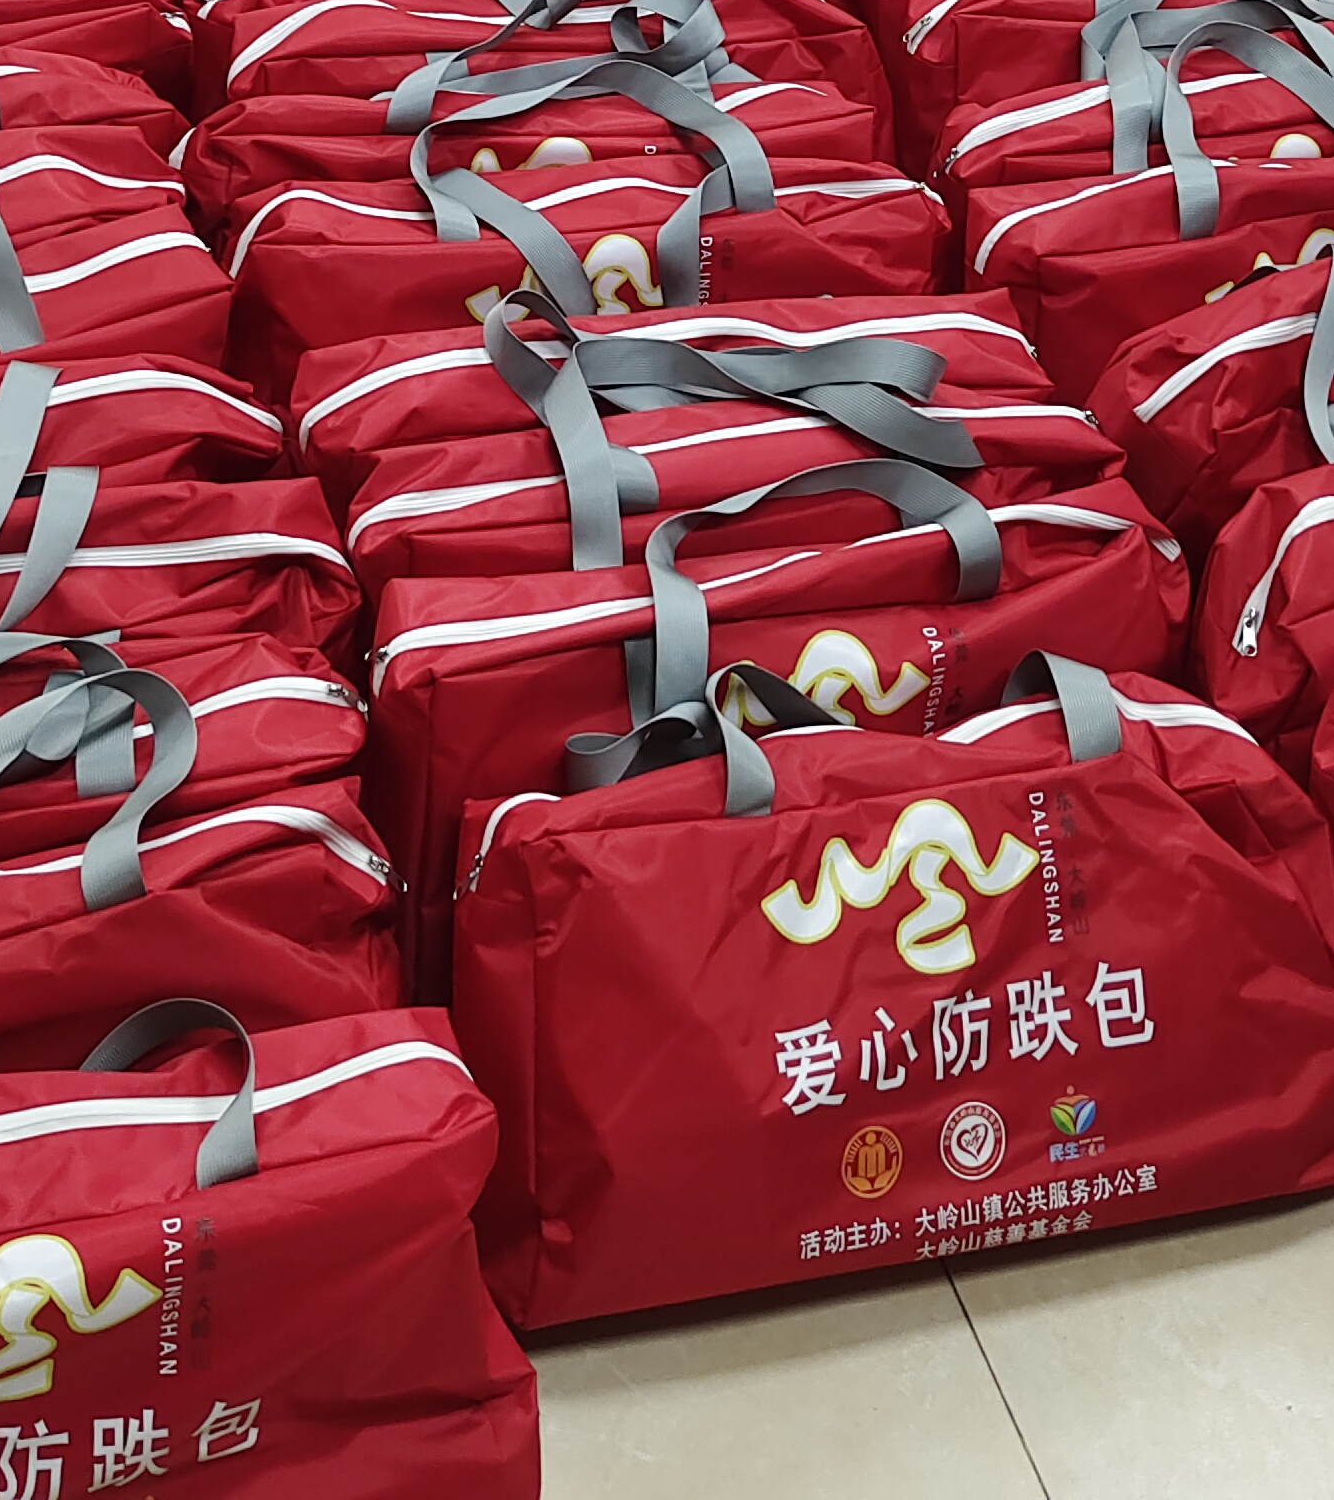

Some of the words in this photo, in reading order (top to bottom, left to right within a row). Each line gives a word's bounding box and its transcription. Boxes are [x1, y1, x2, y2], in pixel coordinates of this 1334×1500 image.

[1028, 791, 1065, 943] DALINGSHAN
[774, 960, 1156, 1116] 爱心防跌包
[914, 1164, 1159, 1238] 大岭山镇公共服务办公室
[158, 1217, 184, 1375] DALINGSHAN
